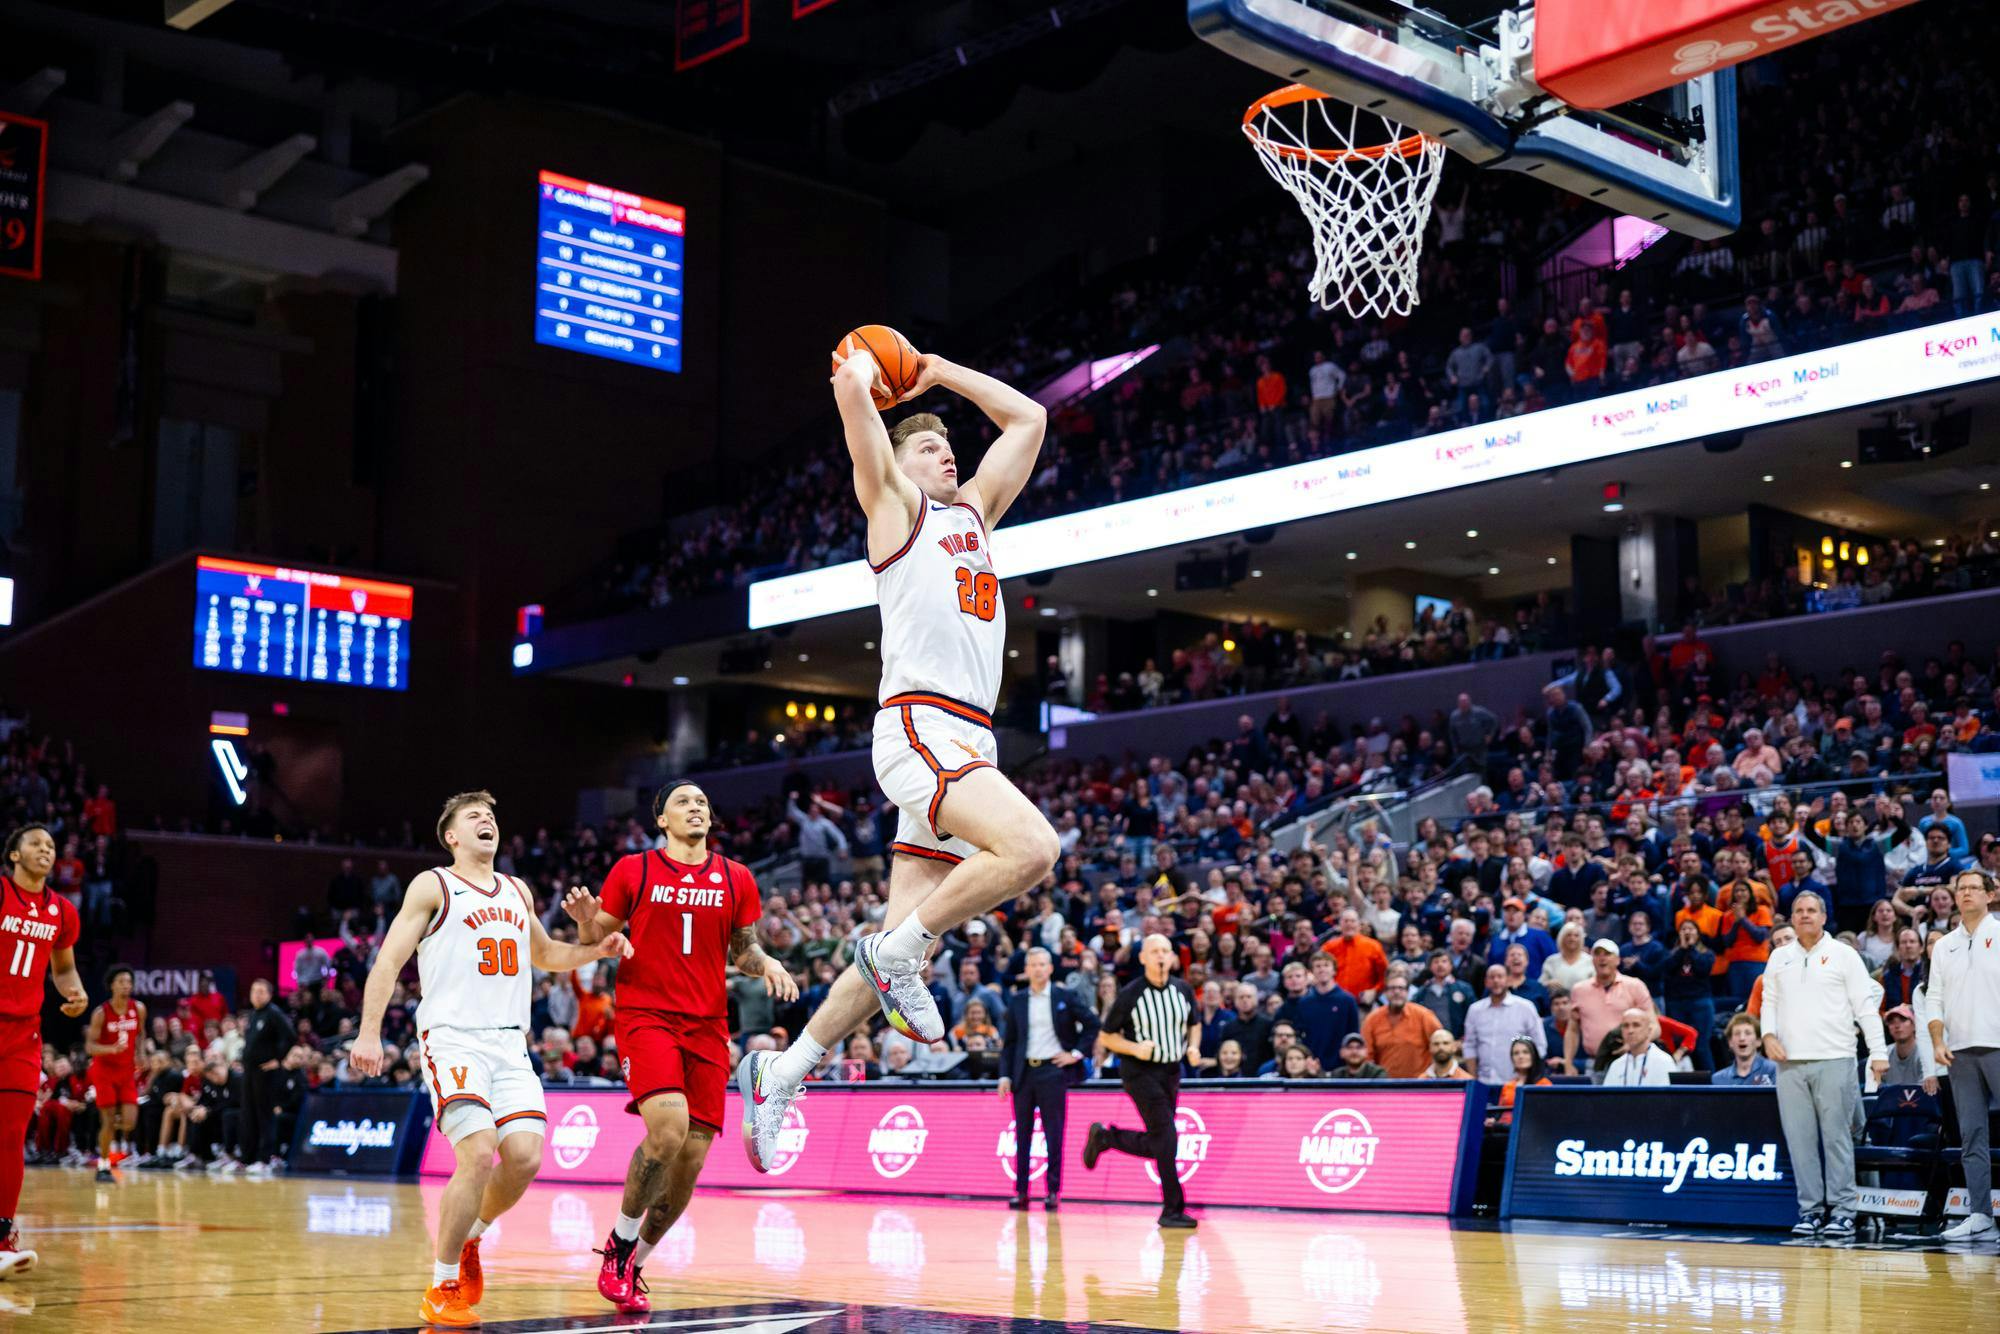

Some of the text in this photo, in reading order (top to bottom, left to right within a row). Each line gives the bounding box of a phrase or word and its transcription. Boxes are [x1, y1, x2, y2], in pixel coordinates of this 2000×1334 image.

[1793, 362, 1839, 384] Mobil
[955, 565, 998, 622] 28
[650, 884, 725, 907] NC STATE
[1, 915, 57, 941] NC STATE
[463, 906, 525, 933] VIRGINIA
[682, 912, 693, 955] 1
[9, 939, 36, 978] 11
[477, 937, 519, 976] 30
[450, 1066, 468, 1090] V
[1299, 1135, 1380, 1166] MARKET
[1554, 1136, 1777, 1194] Smithfield
[1862, 1194, 1920, 1208] UVA Health
